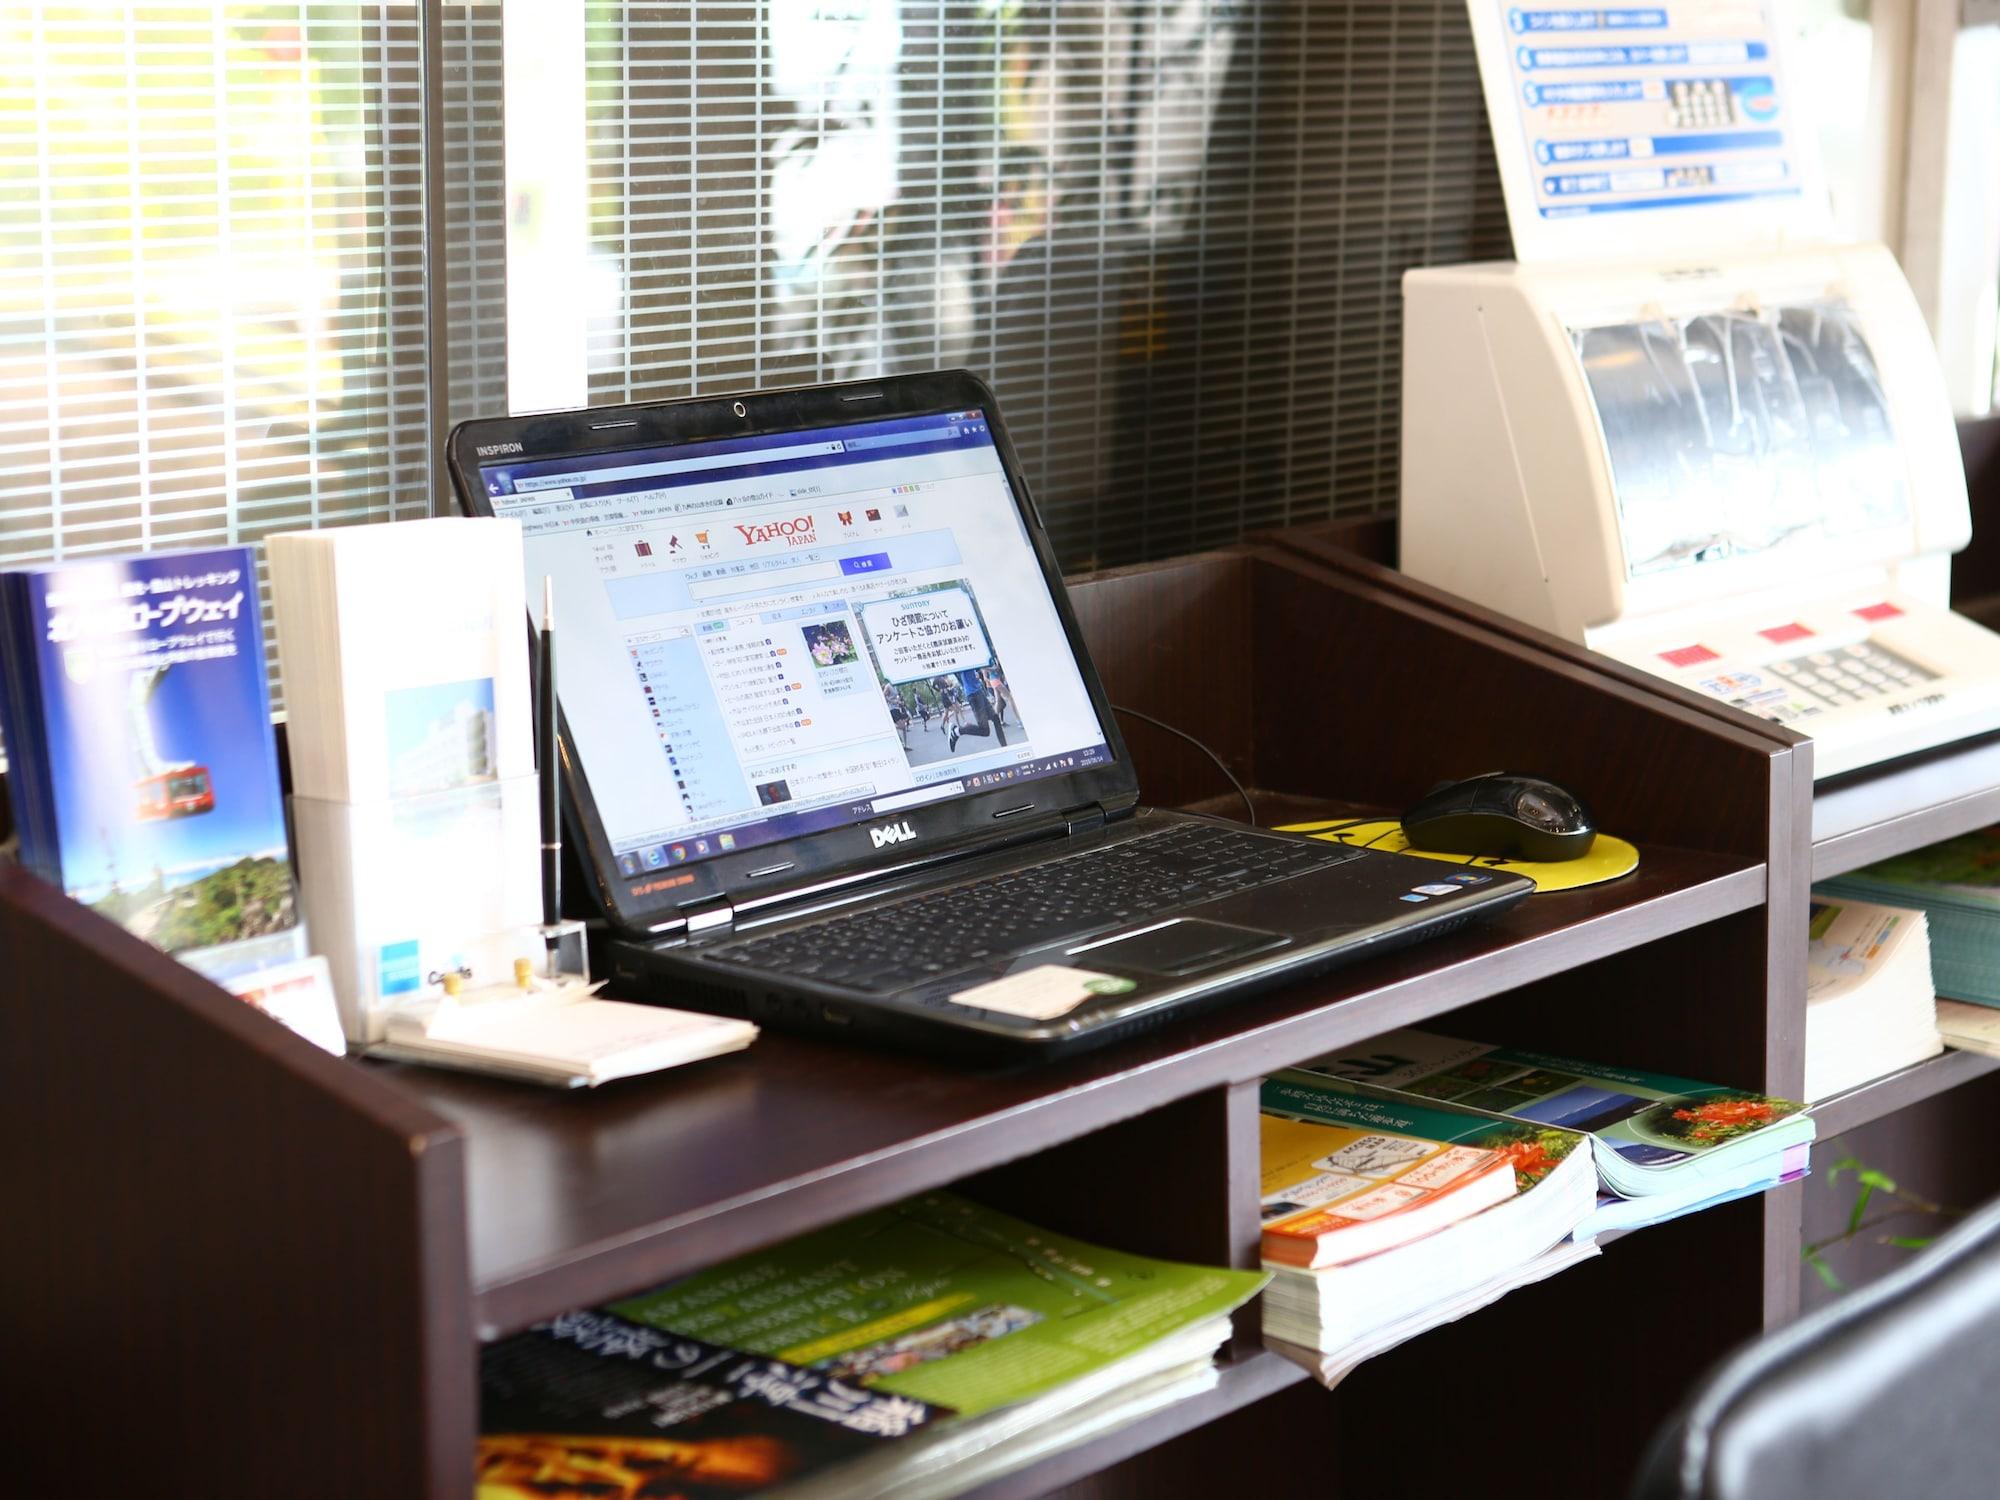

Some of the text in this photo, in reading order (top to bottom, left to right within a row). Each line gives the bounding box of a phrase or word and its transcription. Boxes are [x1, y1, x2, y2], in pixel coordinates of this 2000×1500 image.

[477, 443, 523, 456] INSPIRON
[734, 515, 815, 546] YAHOO!
[786, 533, 817, 547] JAPAN
[900, 600, 930, 611] SUNTORY
[891, 609, 949, 627] ひざ関節について
[876, 618, 973, 645] アンケートご協力のお願い
[852, 804, 872, 815] アドレス
[870, 821, 917, 849] DELL
